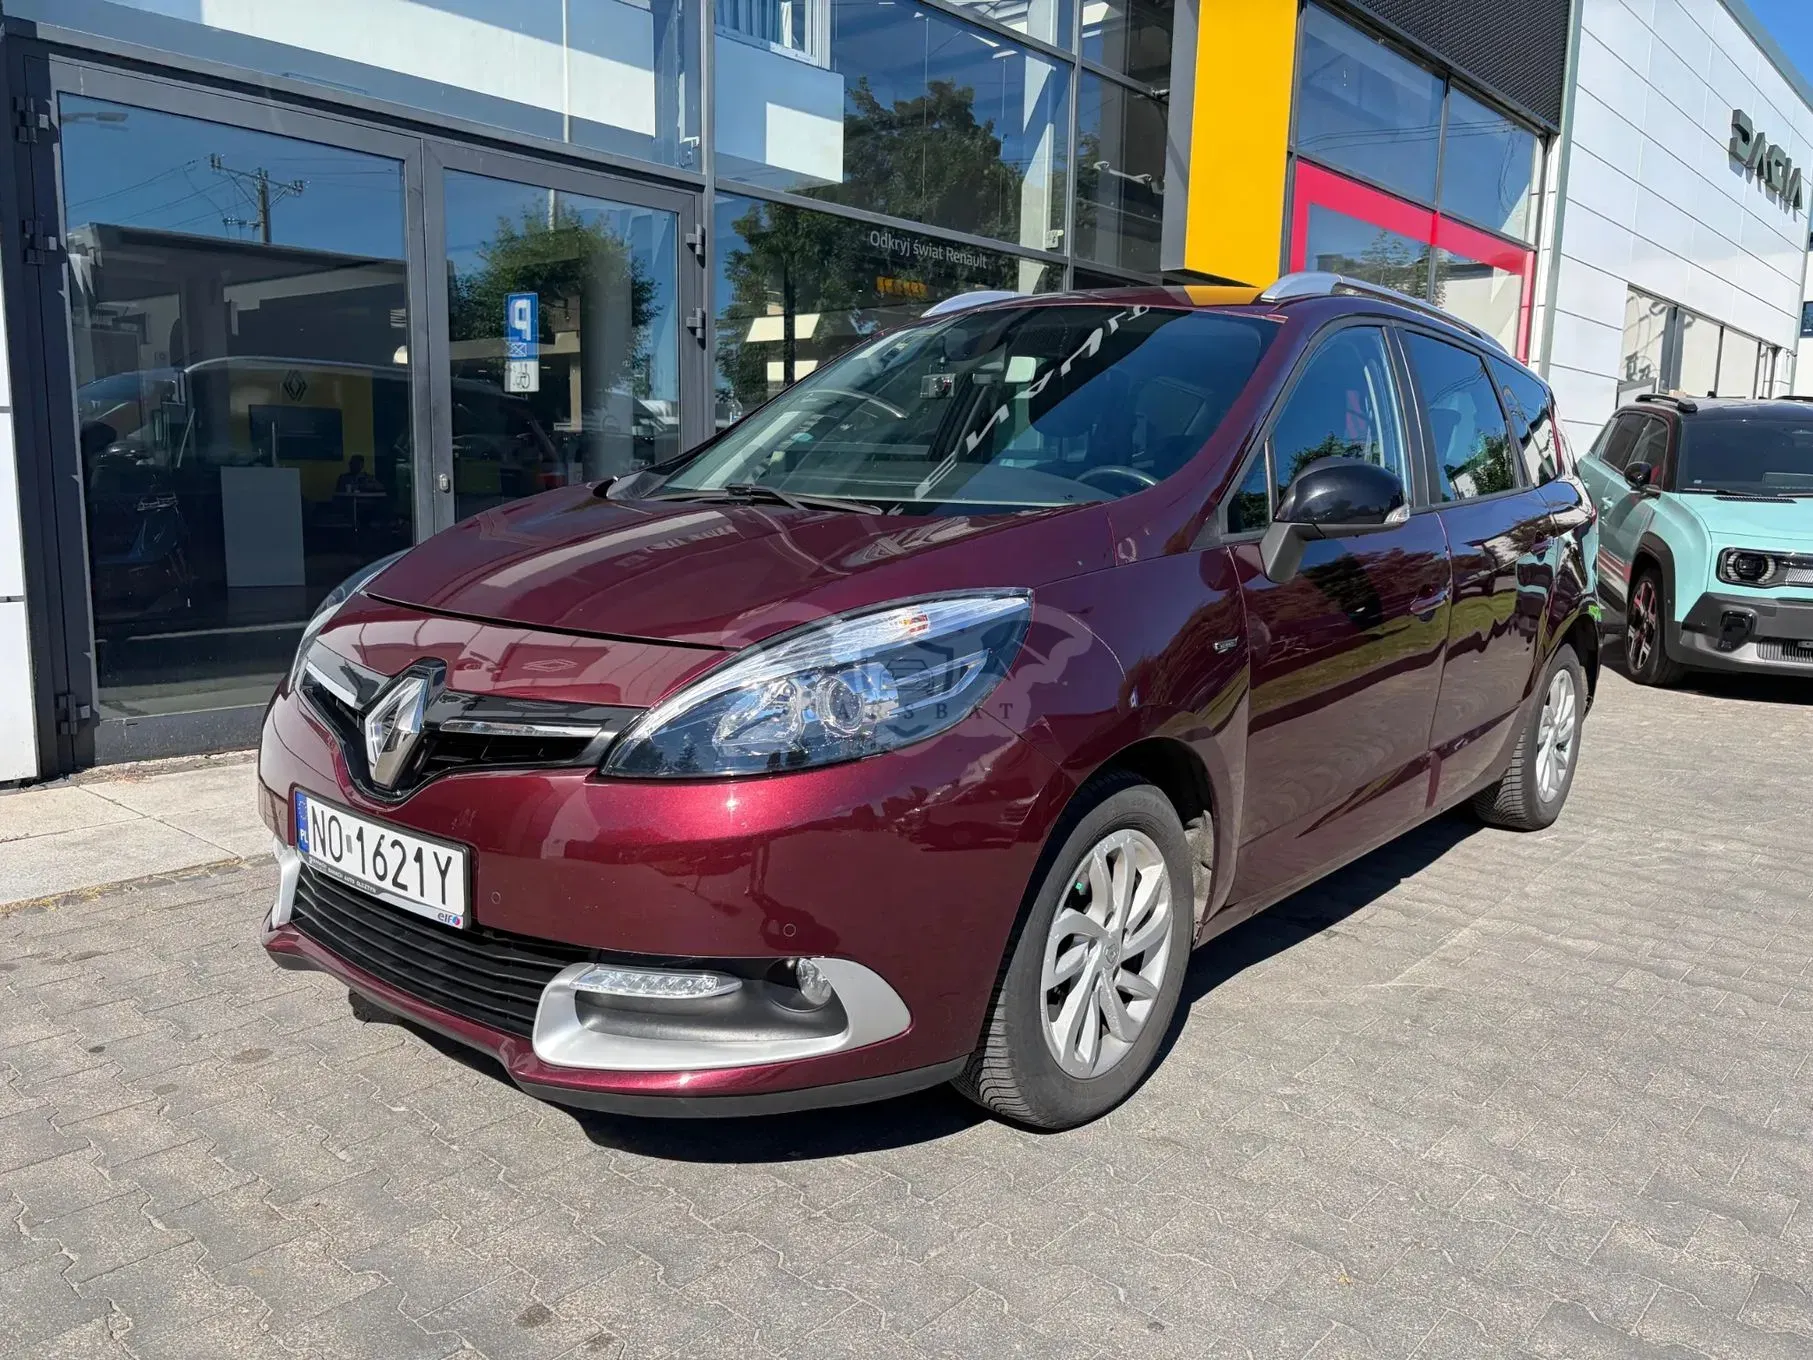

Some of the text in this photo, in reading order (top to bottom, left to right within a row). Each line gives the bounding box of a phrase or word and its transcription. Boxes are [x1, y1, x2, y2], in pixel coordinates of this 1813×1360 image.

[1728, 109, 1803, 210] DACIA
[870, 231, 987, 269] Odkryj świat Renault
[300, 829, 309, 843] PL
[311, 805, 453, 905] NO 1621Y
[437, 912, 453, 924] elf
